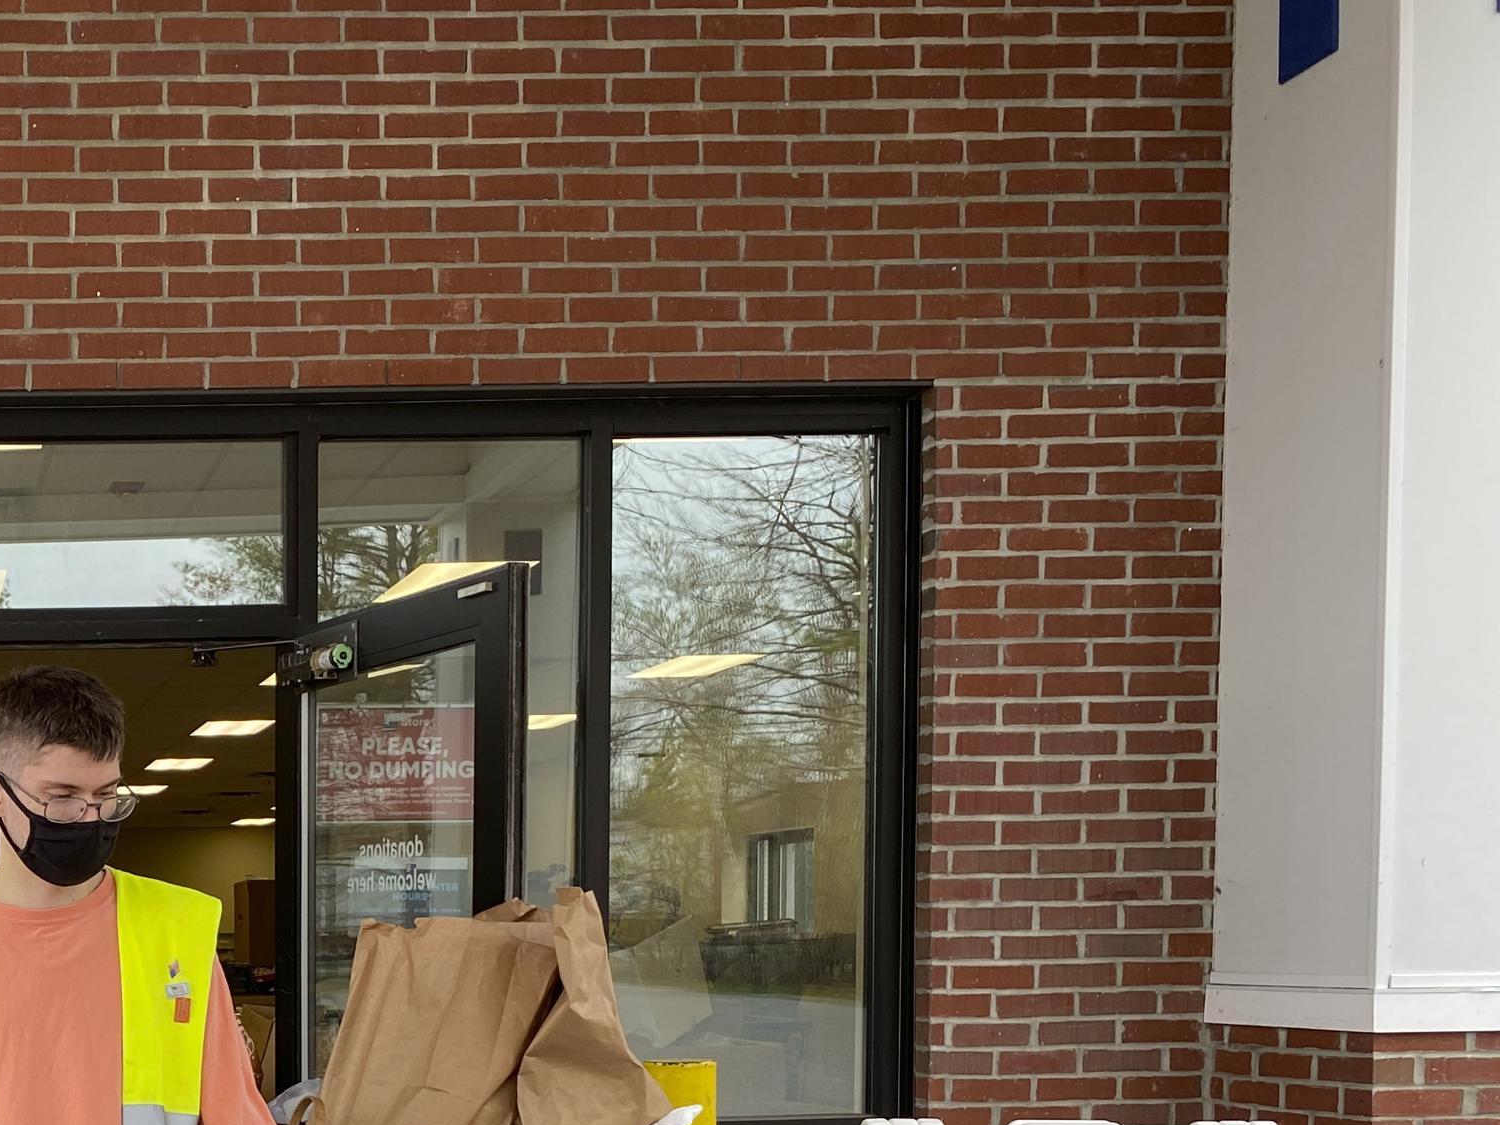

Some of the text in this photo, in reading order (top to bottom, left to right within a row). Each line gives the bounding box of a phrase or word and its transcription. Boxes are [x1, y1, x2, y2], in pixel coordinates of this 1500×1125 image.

[362, 736, 449, 757] PLEASE,
[328, 760, 475, 780] NO DUMPING
